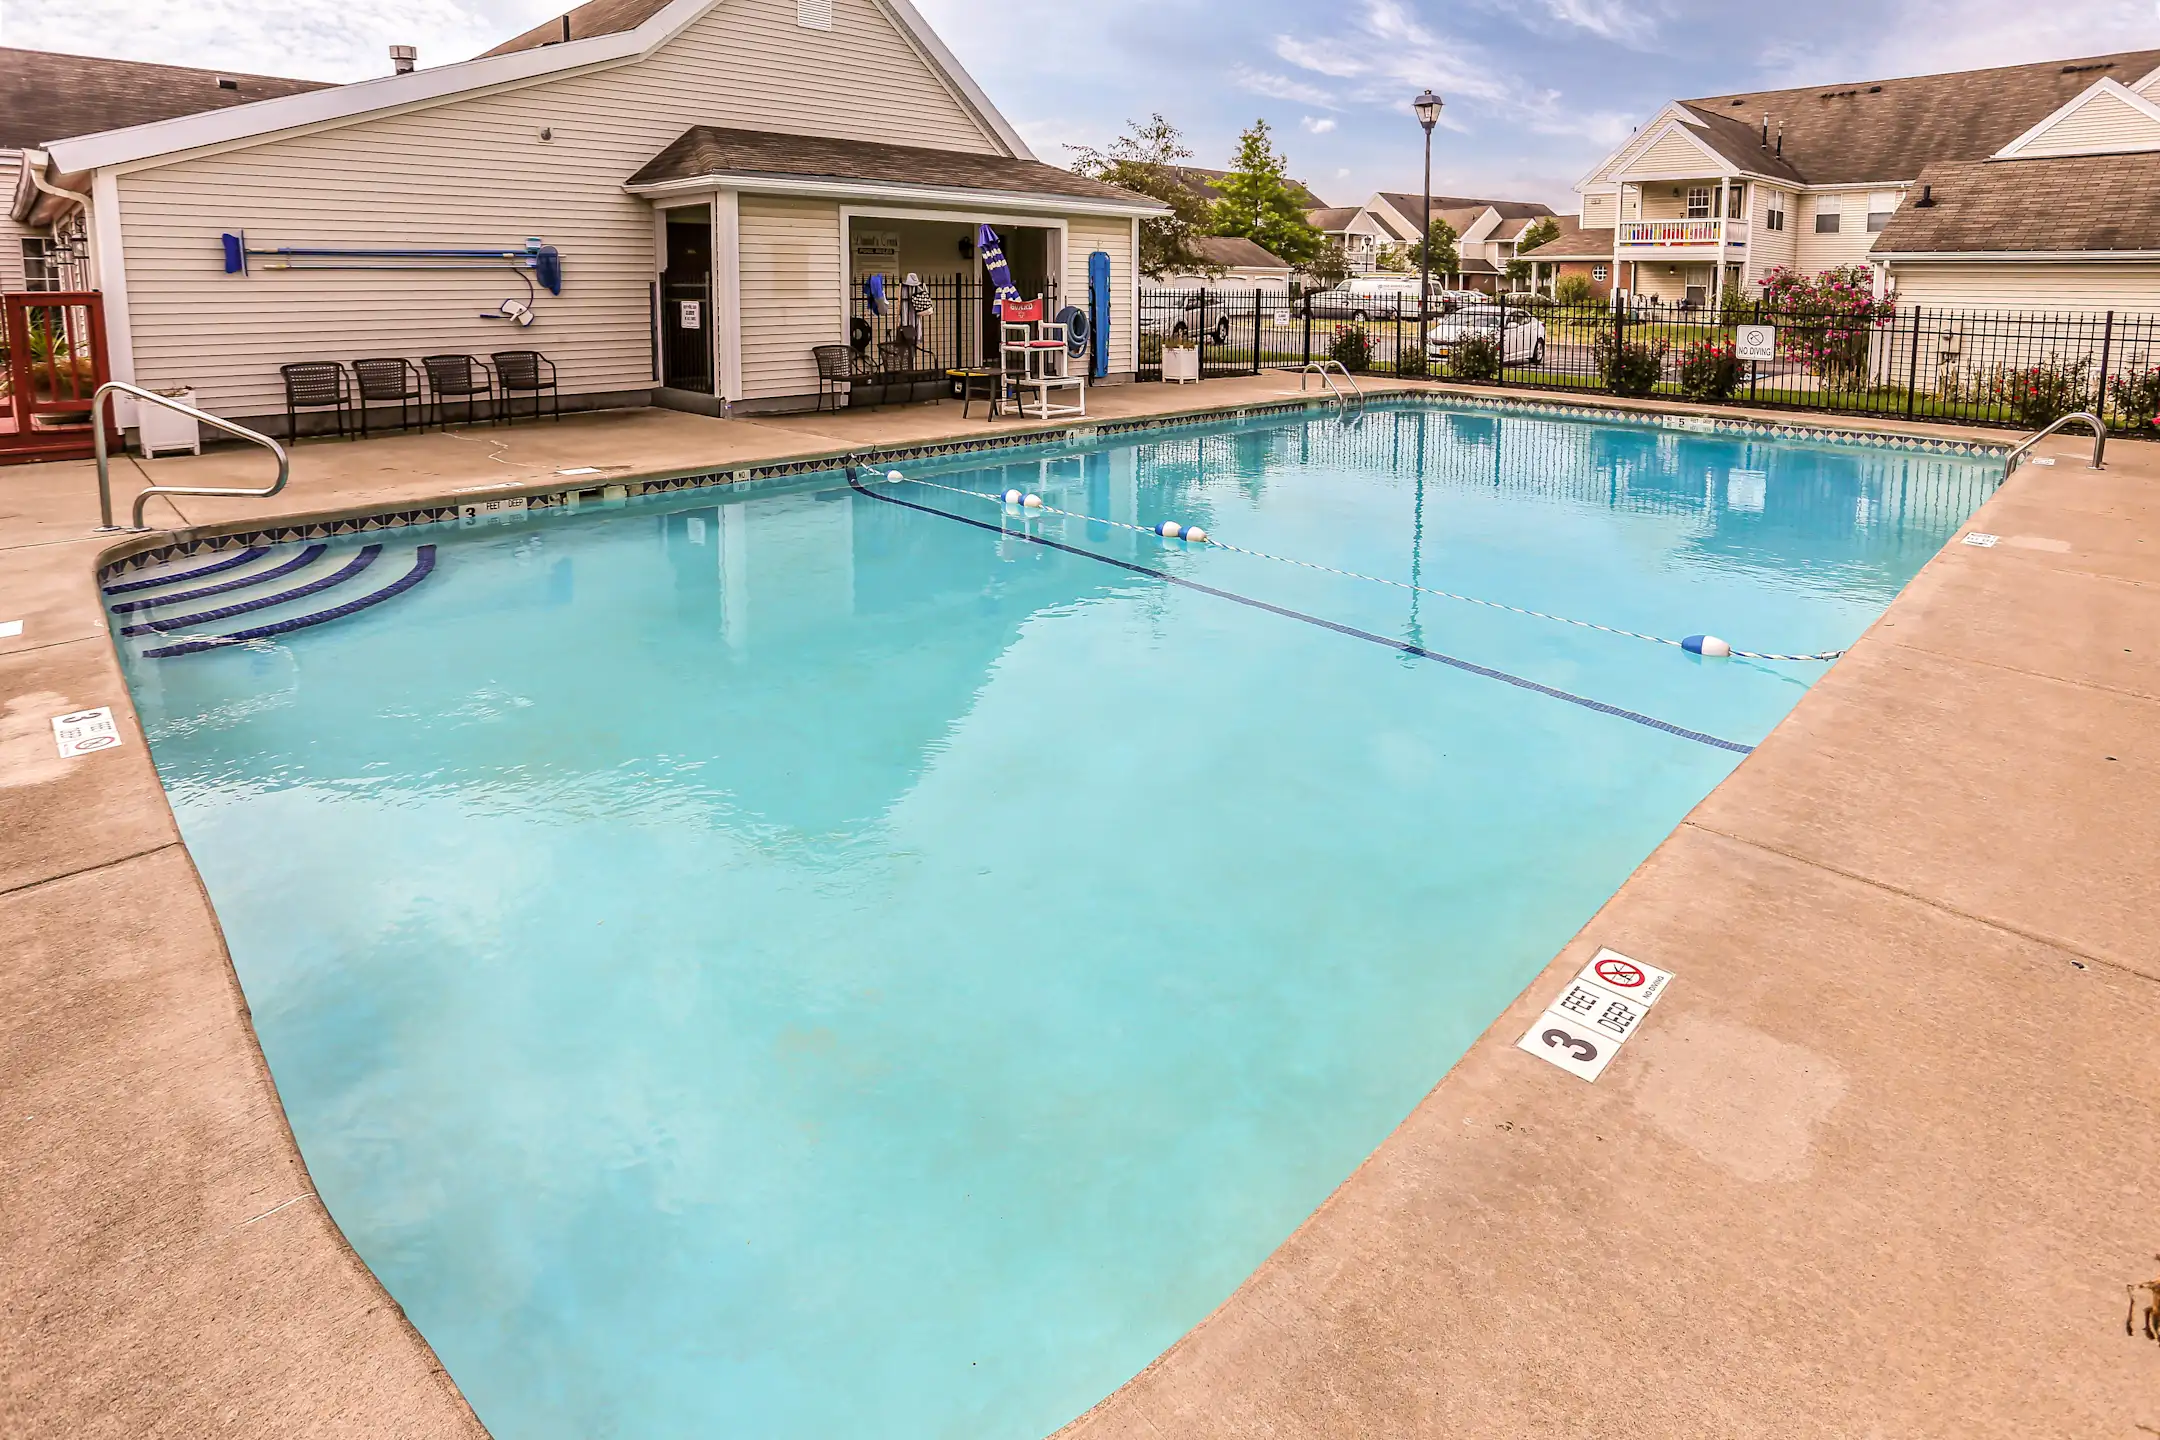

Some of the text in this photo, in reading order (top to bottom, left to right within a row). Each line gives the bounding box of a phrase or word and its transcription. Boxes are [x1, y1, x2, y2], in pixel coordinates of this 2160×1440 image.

[1739, 346, 1771, 356] NO DIVING
[1679, 418, 1685, 426] 5
[465, 499, 523, 519] 3 FEET DEEP
[62, 712, 103, 723] 3
[1642, 975, 1664, 999] NO DIVING
[1560, 985, 1600, 1016] FEET
[1597, 1001, 1637, 1034] DEEP
[1541, 1028, 1598, 1062] 3
